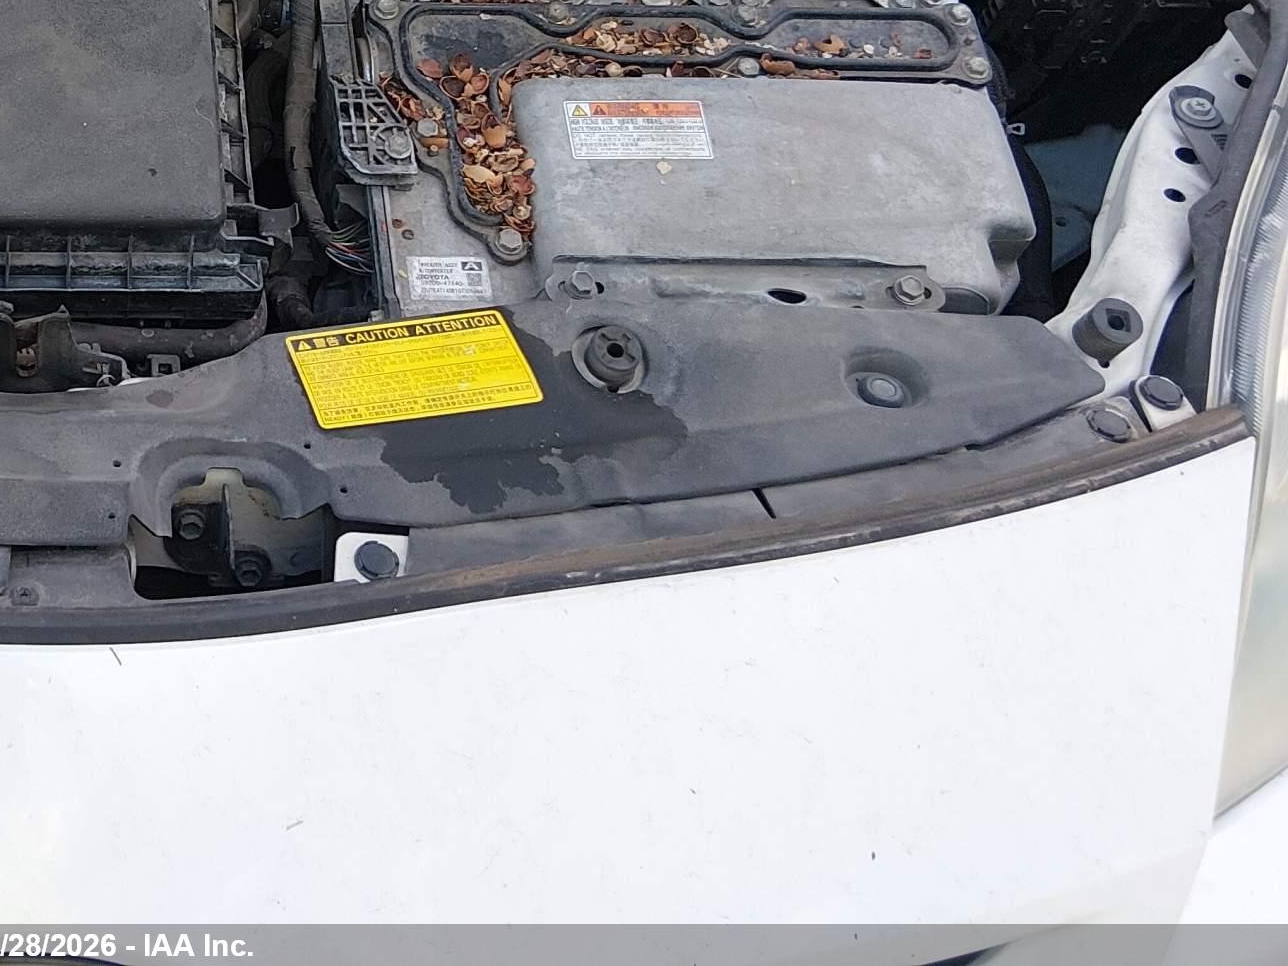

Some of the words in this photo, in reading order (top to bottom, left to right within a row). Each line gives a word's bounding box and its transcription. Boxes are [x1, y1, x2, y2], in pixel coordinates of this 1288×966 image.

[345, 326, 410, 345] CAUTION
[415, 314, 498, 336] ATTENTION
[313, 335, 340, 349] 警告
